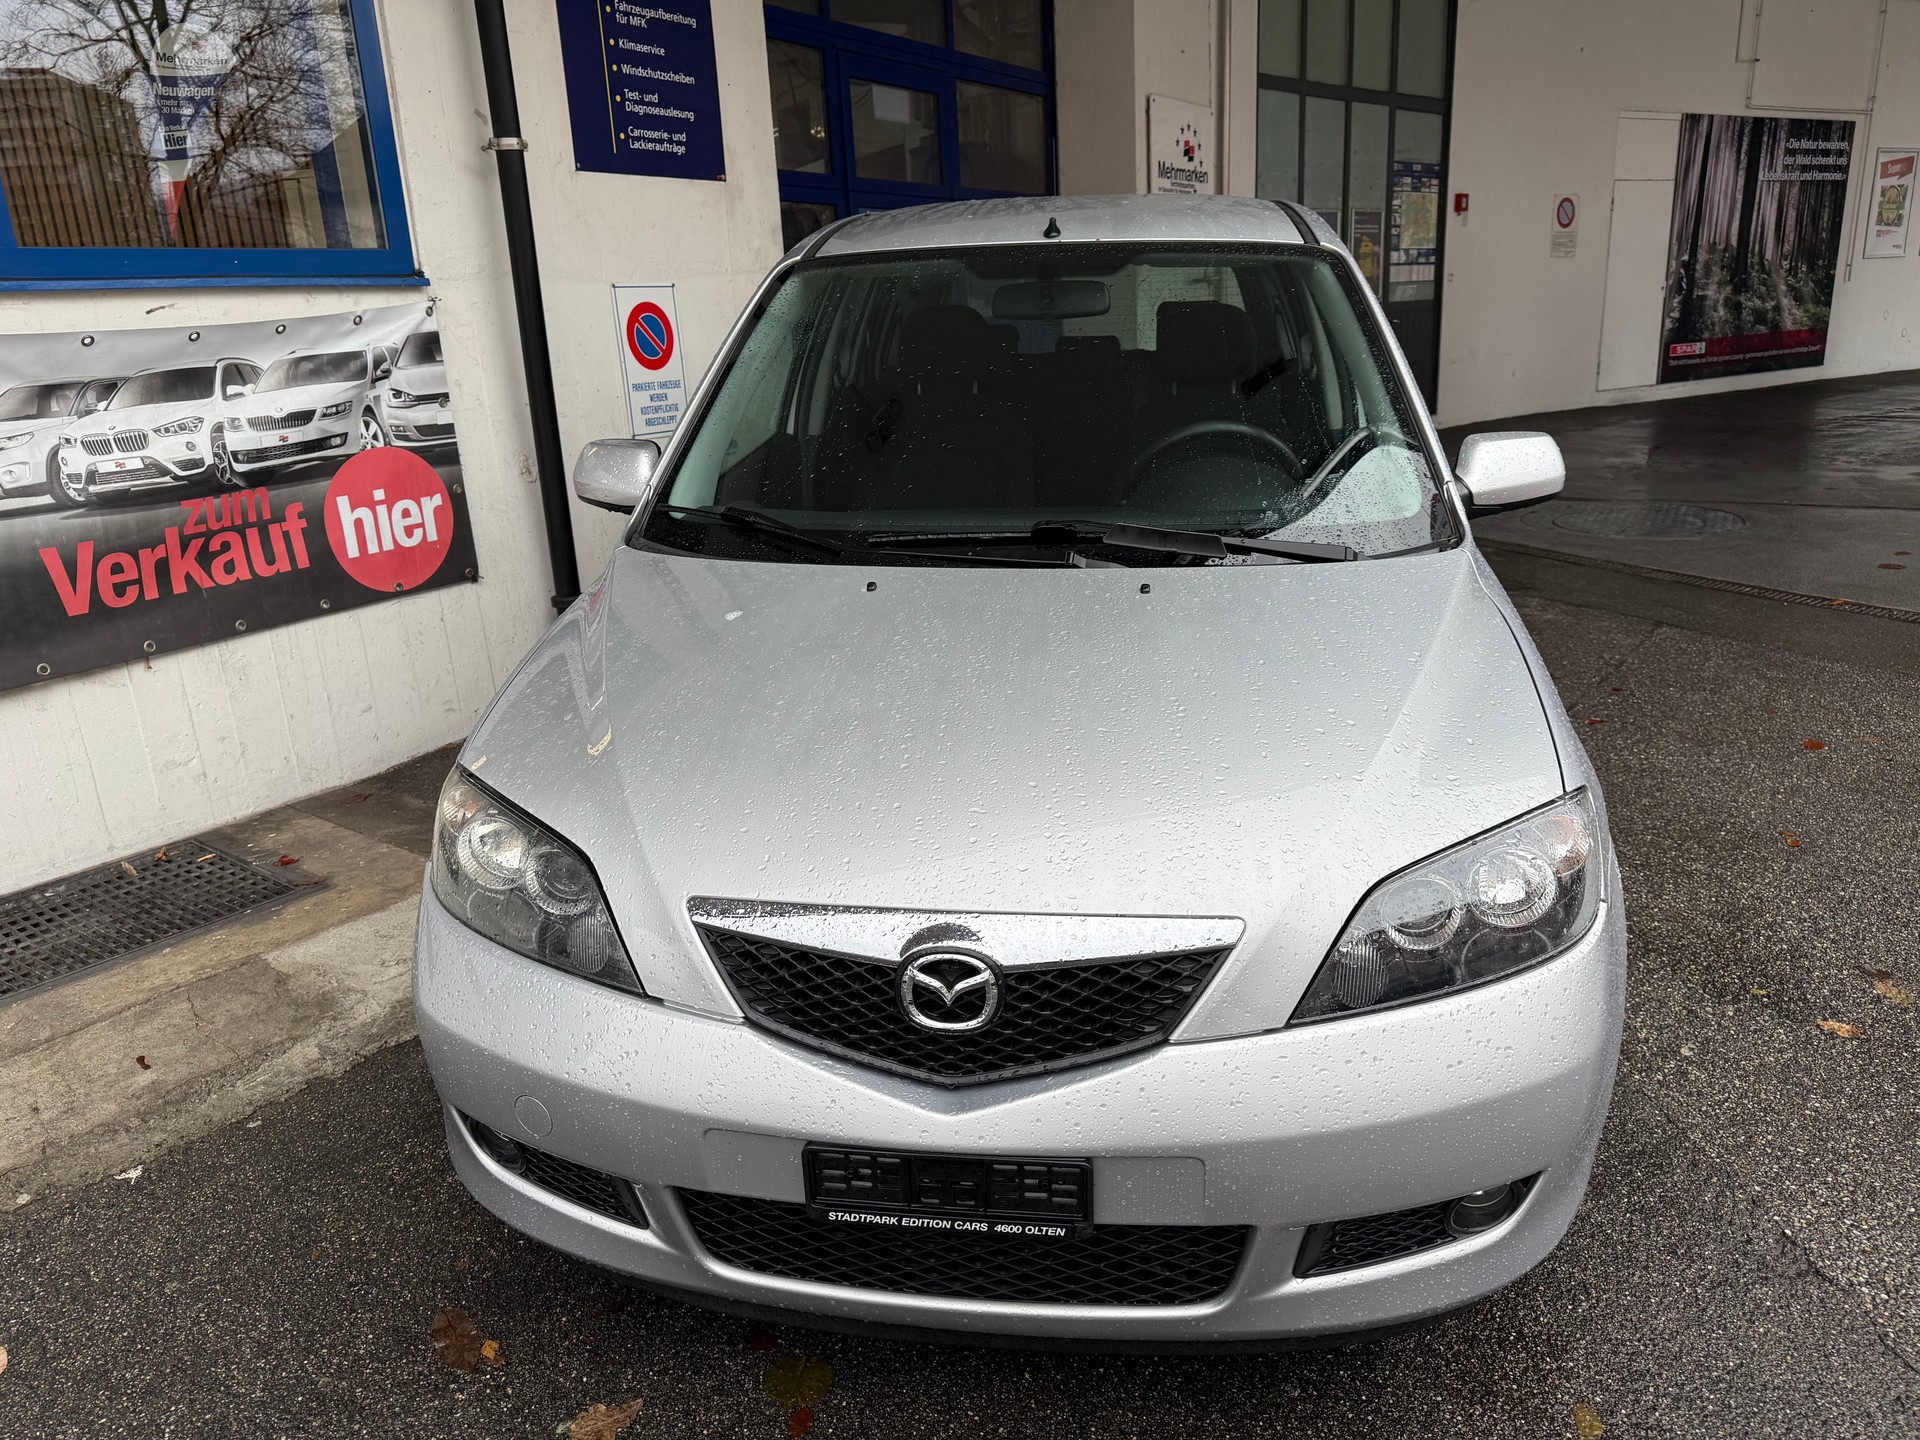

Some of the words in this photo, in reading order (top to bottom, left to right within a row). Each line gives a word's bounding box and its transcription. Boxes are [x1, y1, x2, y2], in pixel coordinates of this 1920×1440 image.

[614, 0, 697, 28] Fahrzeugaufbereitung
[615, 12, 628, 24] für
[629, 15, 648, 29] MFK
[618, 38, 666, 56] Klimaservice
[621, 64, 695, 84] Windschutzscheiben
[152, 82, 215, 99] Neuwagen
[623, 88, 642, 101] Test-
[643, 93, 659, 103] und
[161, 106, 170, 114] 30
[625, 101, 695, 122] Diagnoseauslesung
[163, 133, 188, 148] Hier
[627, 126, 671, 140] Carrosserie-
[672, 131, 687, 142] und
[629, 139, 686, 155] Lackieraufträge
[1800, 138, 1818, 150] Natur
[1783, 154, 1796, 165] der
[1796, 154, 1812, 165] Wald
[1812, 155, 1836, 165] schenkt
[1836, 157, 1848, 166] uns
[1158, 160, 1208, 183] Mehrmarken
[1761, 170, 1800, 181] Lebenskraft
[1801, 170, 1812, 180] und
[1675, 345, 1698, 355] SPAR
[632, 381, 656, 392] PARKIERTE
[657, 379, 682, 389] FAHRZEUGE
[650, 393, 668, 402] WERDEN
[640, 403, 679, 415] KOSTENPFLICHTIG
[645, 415, 678, 427] ABGESCHLEPPT
[180, 487, 271, 536] zum
[336, 488, 443, 559] hier
[38, 502, 310, 617] Verkauf
[828, 1211, 899, 1226] STADTPARK
[901, 1217, 952, 1229] EDITION
[954, 1221, 988, 1232] CARS
[994, 1224, 1022, 1234] 4600
[1025, 1225, 1066, 1237] OLTEN
